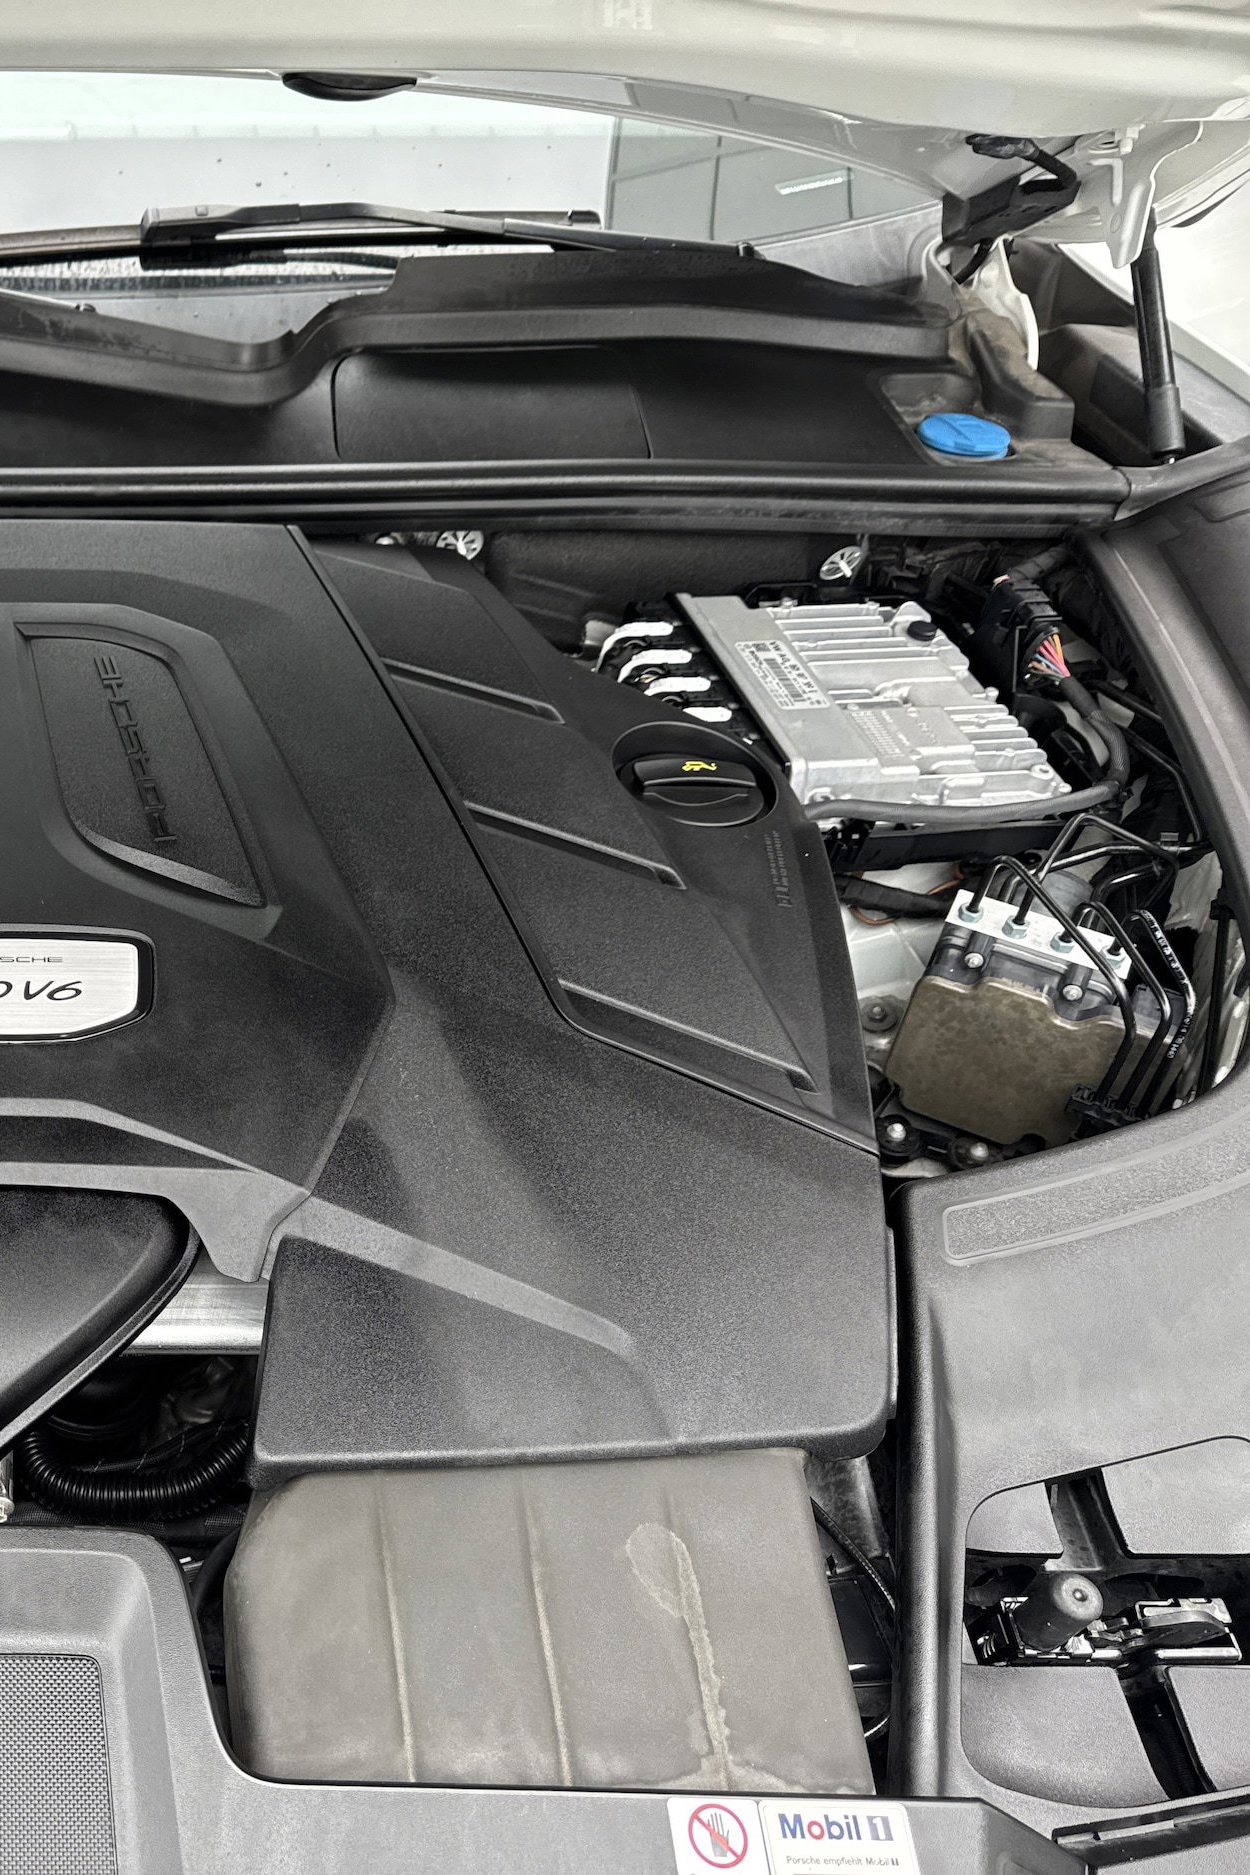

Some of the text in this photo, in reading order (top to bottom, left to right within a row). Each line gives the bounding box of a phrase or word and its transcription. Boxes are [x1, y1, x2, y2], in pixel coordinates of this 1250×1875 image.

[93, 655, 177, 841] PORSCHE
[23, 980, 83, 1001] V6
[778, 1813, 891, 1841] Mobil 1
[786, 1855, 821, 1865] Porsche
[823, 1856, 863, 1867] empfiehlt
[865, 1856, 890, 1866] Mobil
